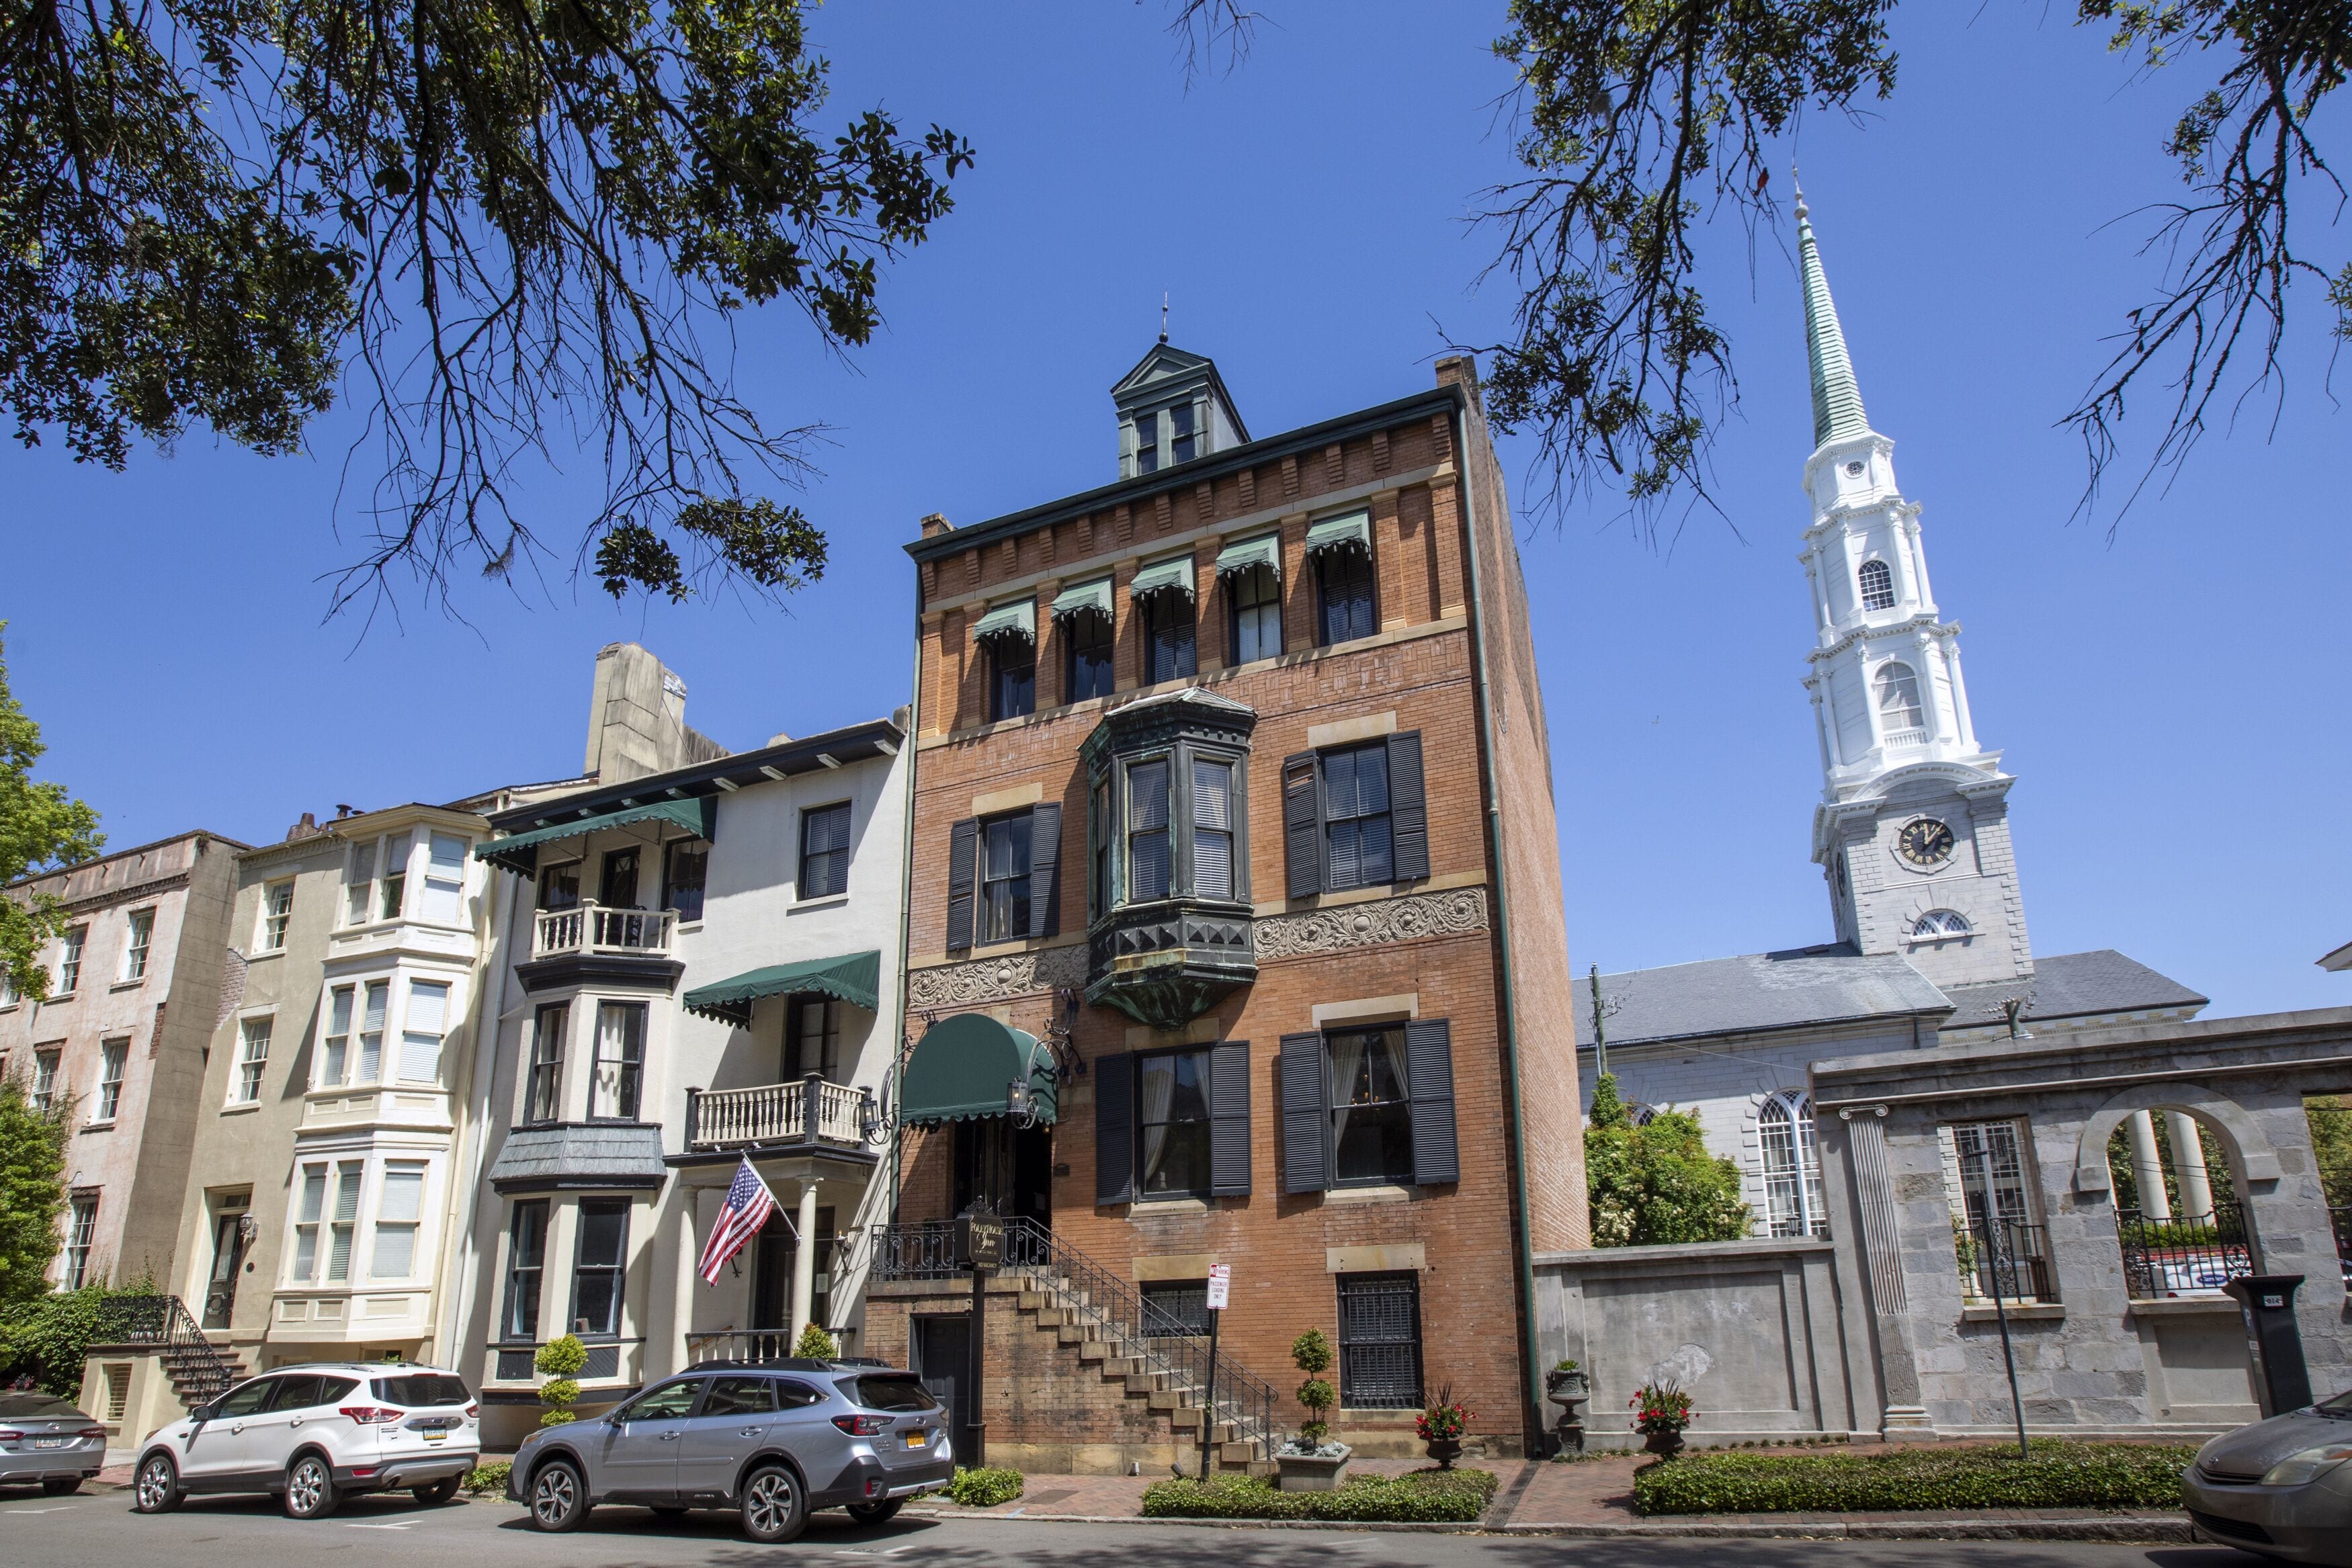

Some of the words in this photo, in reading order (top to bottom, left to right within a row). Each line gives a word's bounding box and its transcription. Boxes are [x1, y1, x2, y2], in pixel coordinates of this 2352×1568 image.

[971, 1223, 986, 1233] FOLEY
[986, 1224, 1003, 1235] HOUSE
[976, 1232, 995, 1249] Inn
[2245, 1308, 2251, 1326] P
